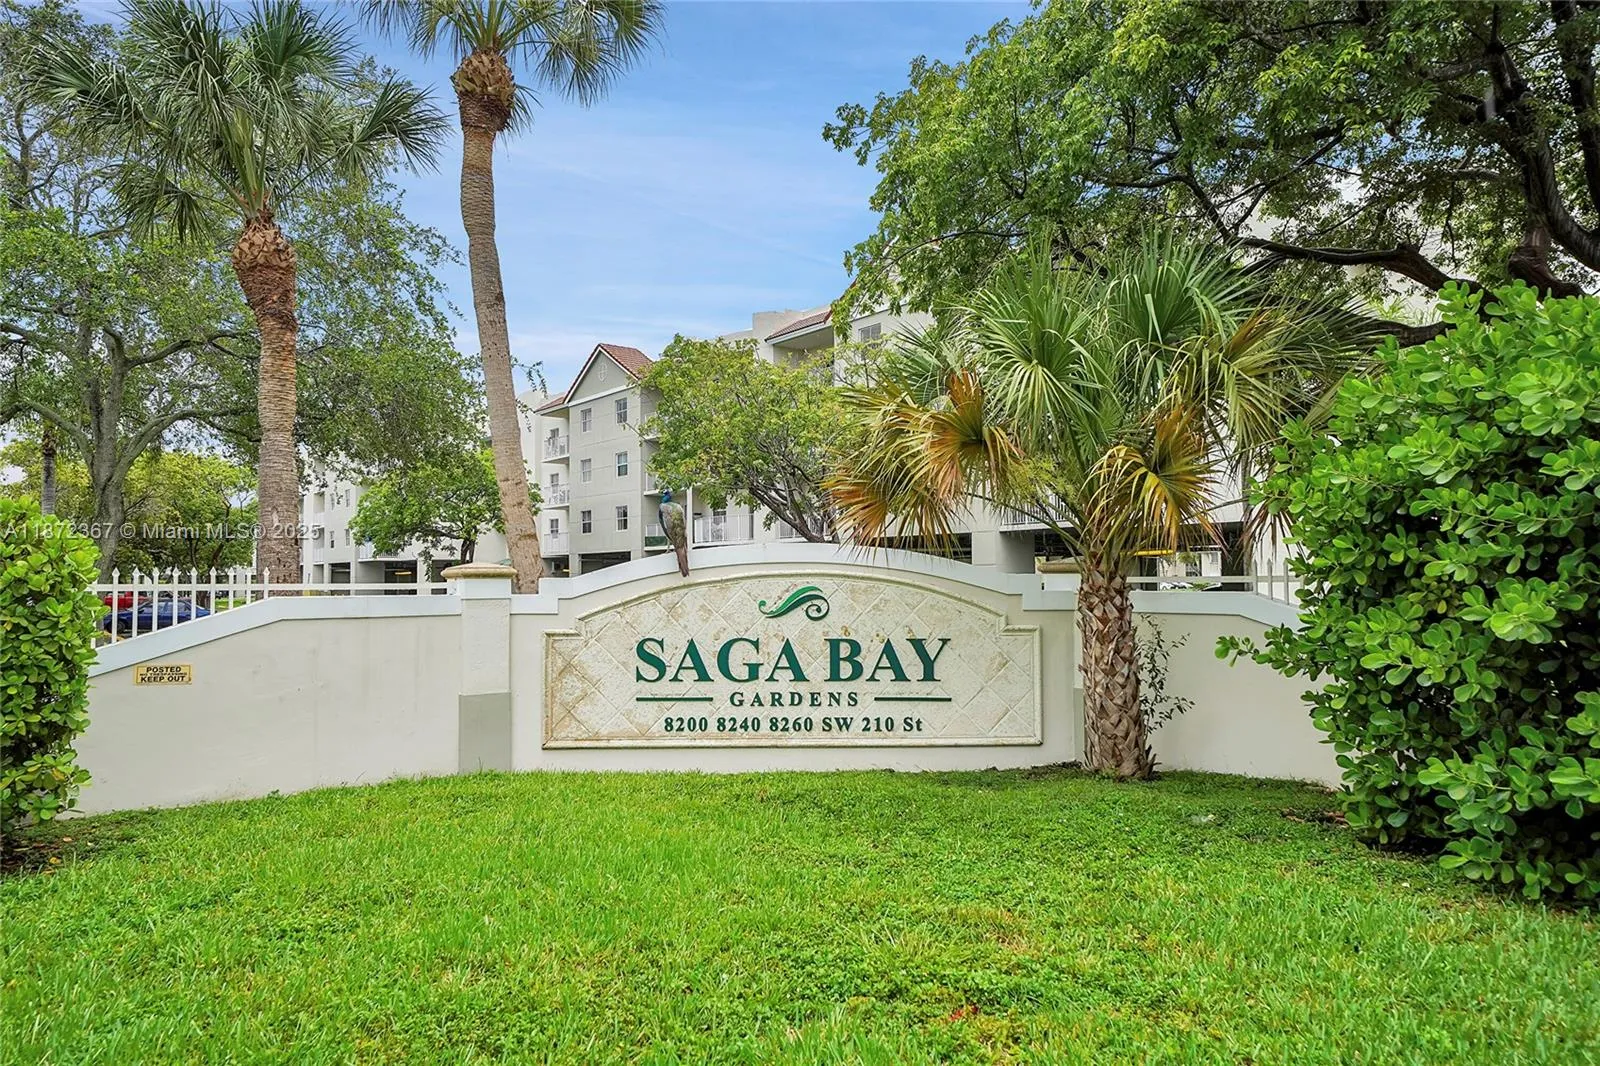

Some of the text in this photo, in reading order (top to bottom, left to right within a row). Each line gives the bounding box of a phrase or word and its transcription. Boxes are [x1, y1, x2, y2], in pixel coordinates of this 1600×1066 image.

[635, 637, 952, 683] SAGA BAY
[729, 691, 859, 707] GARDENS
[664, 716, 923, 732] 8200 8240 8260 SW 210 St
